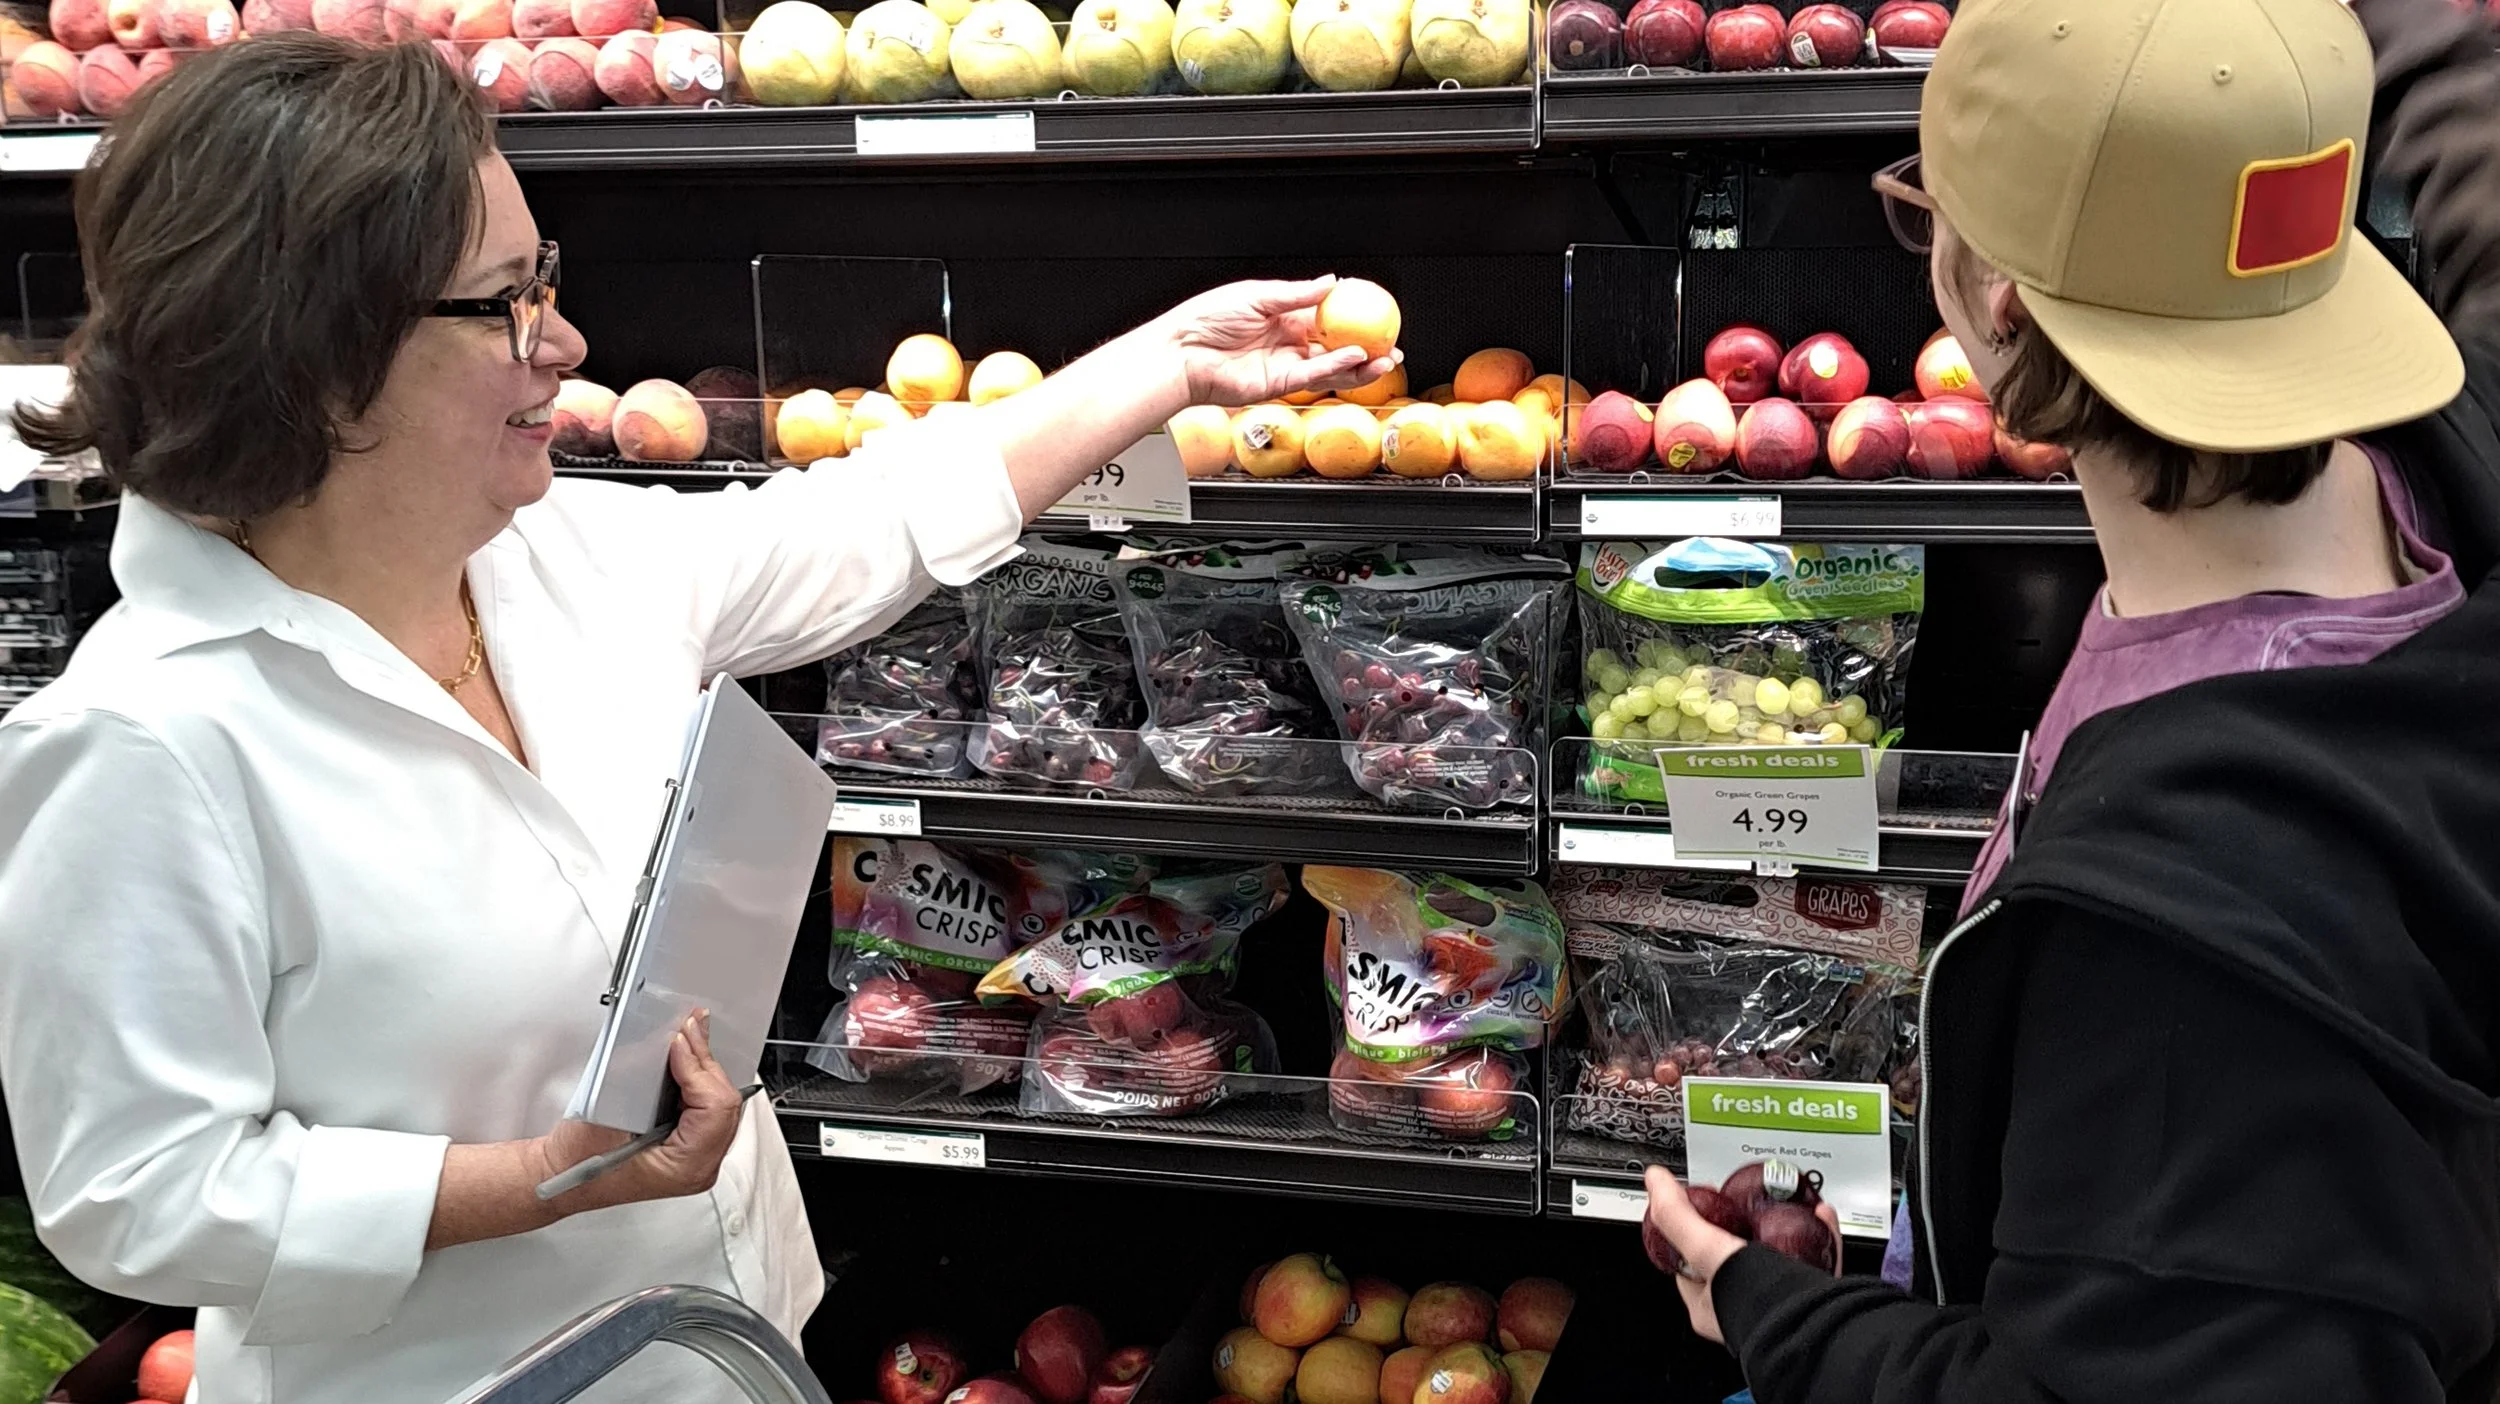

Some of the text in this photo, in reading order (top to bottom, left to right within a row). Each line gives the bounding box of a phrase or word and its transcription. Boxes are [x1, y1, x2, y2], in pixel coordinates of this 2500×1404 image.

[1017, 553, 1105, 573] OLOGIQU
[1795, 547, 1899, 581] Organic
[1686, 754, 1840, 768] fresh deals
[1715, 790, 1820, 801] Organic Green Grapes
[879, 813, 915, 827] $8.99
[1732, 808, 1808, 834] 4.99
[1758, 840, 1774, 849] per
[915, 906, 999, 948] CRISP
[1080, 945, 1158, 970] CRISP
[1114, 1090, 1160, 1108] POIDS
[1162, 1096, 1190, 1108] NET
[1711, 1093, 1859, 1121] fresh deals
[942, 1144, 980, 1160] $5.99
[1741, 1144, 1832, 1160] Organic Red Grapes
